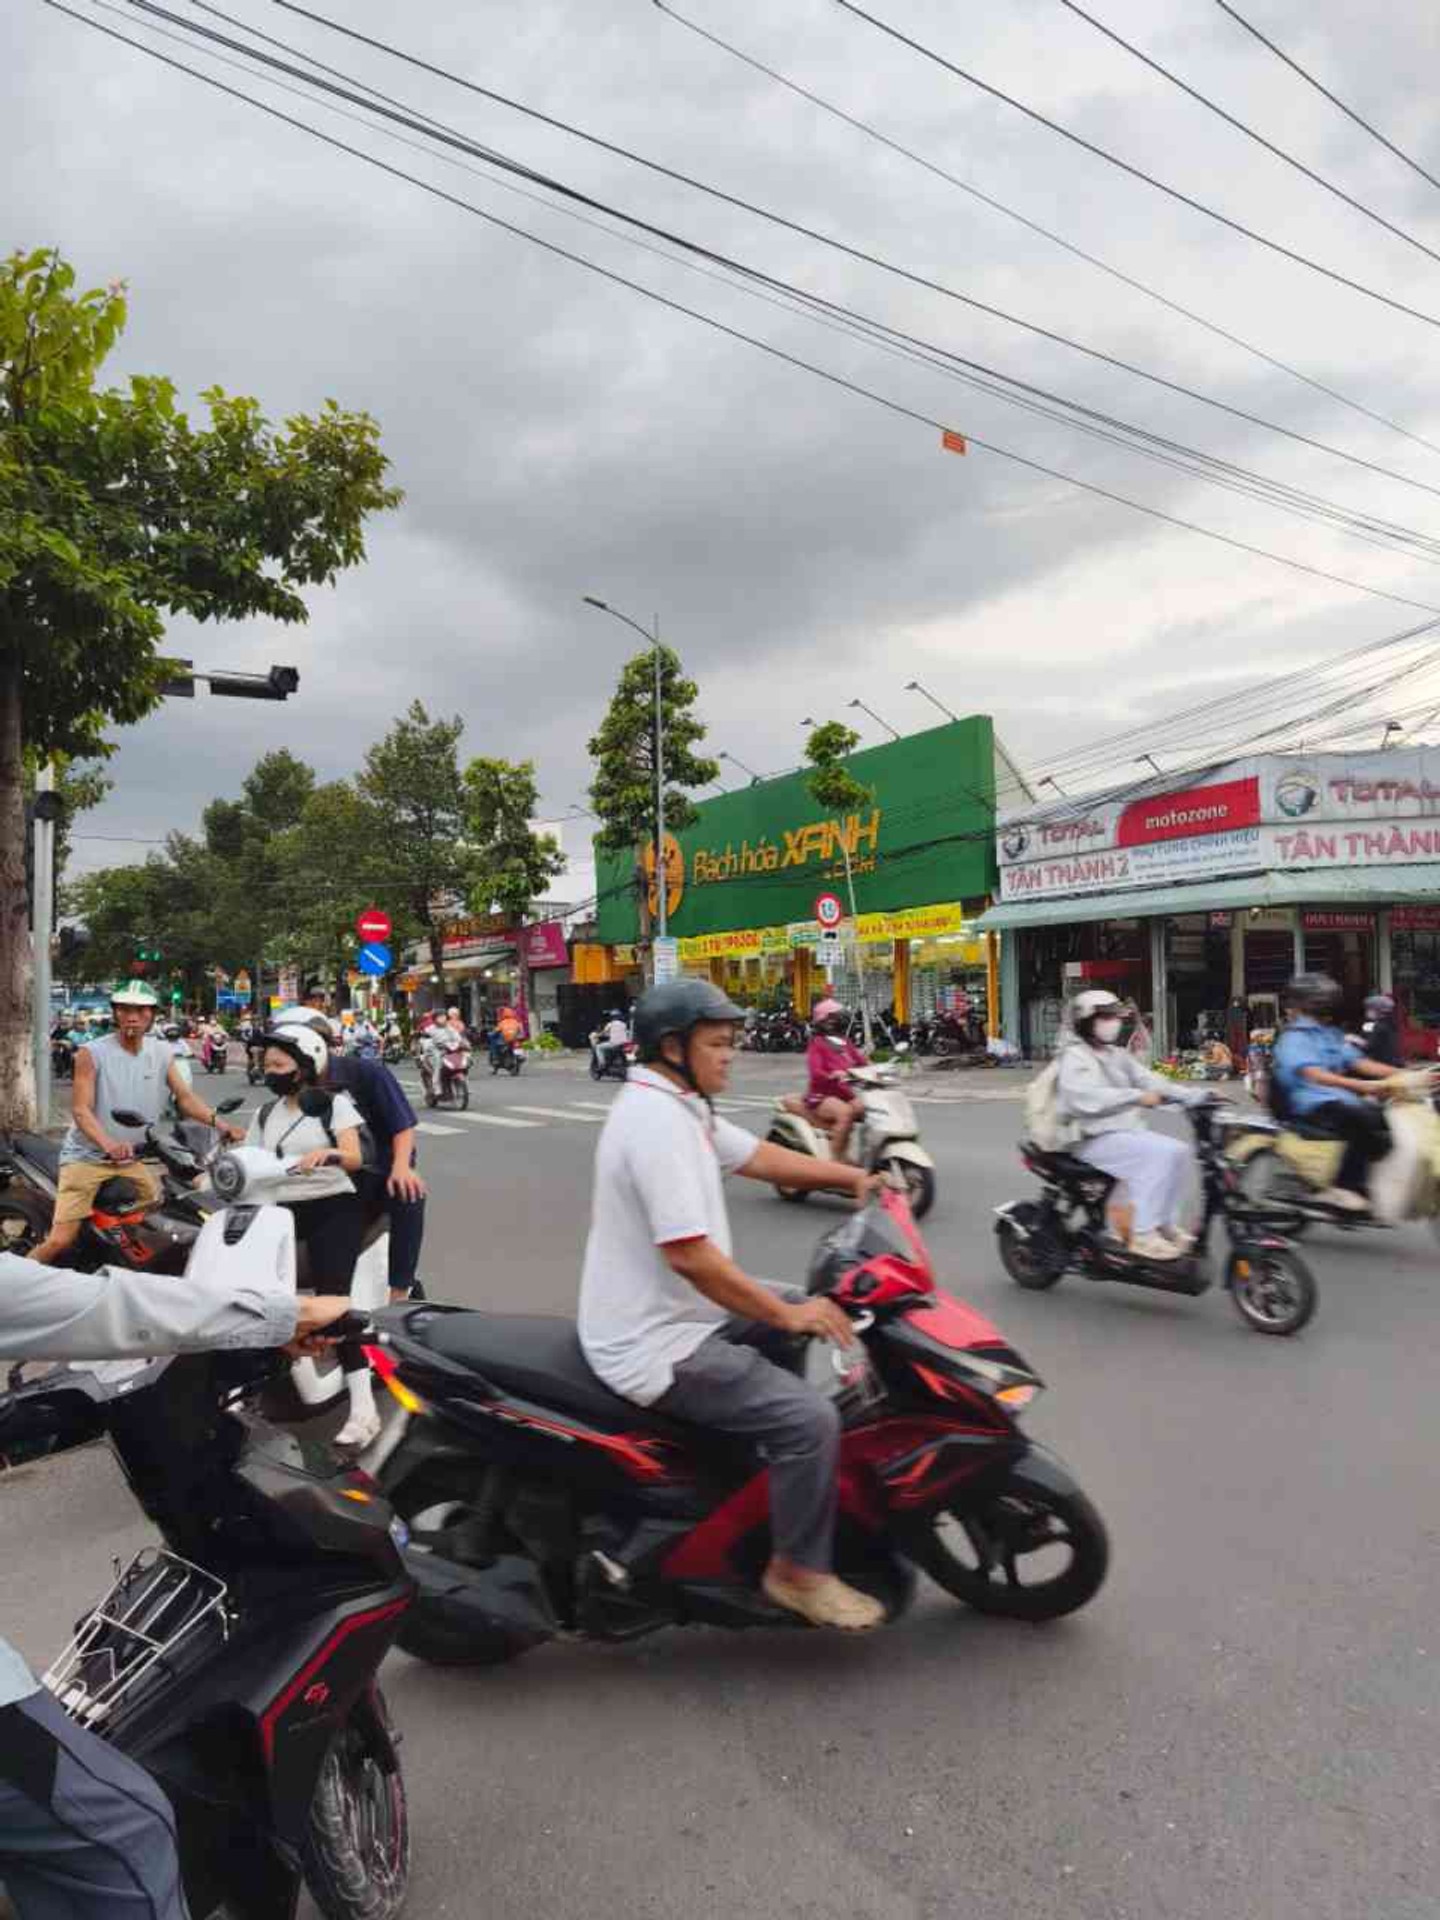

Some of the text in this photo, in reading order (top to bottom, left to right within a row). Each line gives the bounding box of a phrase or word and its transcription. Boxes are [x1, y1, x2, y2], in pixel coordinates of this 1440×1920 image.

[1328, 777, 1440, 803] TOTAL
[1145, 804, 1228, 830] motozone
[782, 808, 881, 864] XANH
[1274, 830, 1337, 861] TÂN
